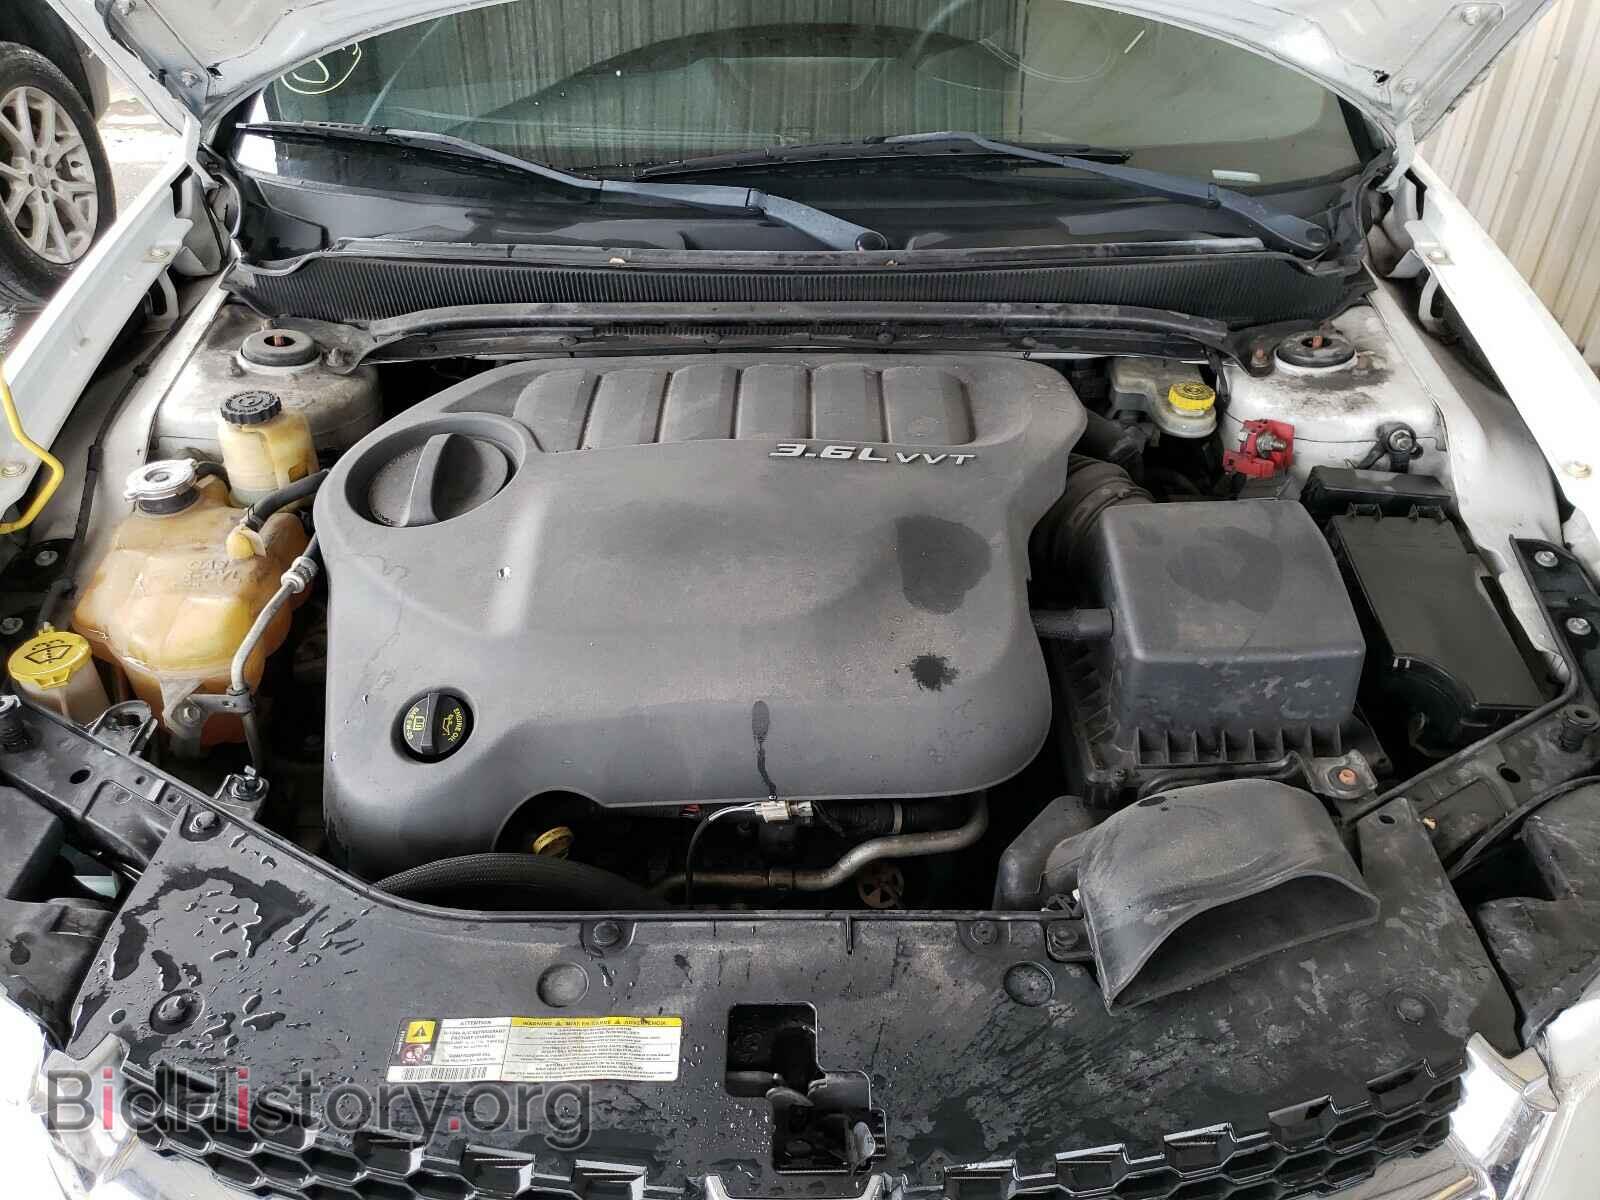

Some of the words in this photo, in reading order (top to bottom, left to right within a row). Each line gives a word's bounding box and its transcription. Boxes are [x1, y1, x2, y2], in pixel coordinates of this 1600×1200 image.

[769, 443, 888, 463] 3.6L
[896, 452, 976, 465] VVT
[453, 707, 463, 732] ENGINE
[447, 732, 459, 743] OIL
